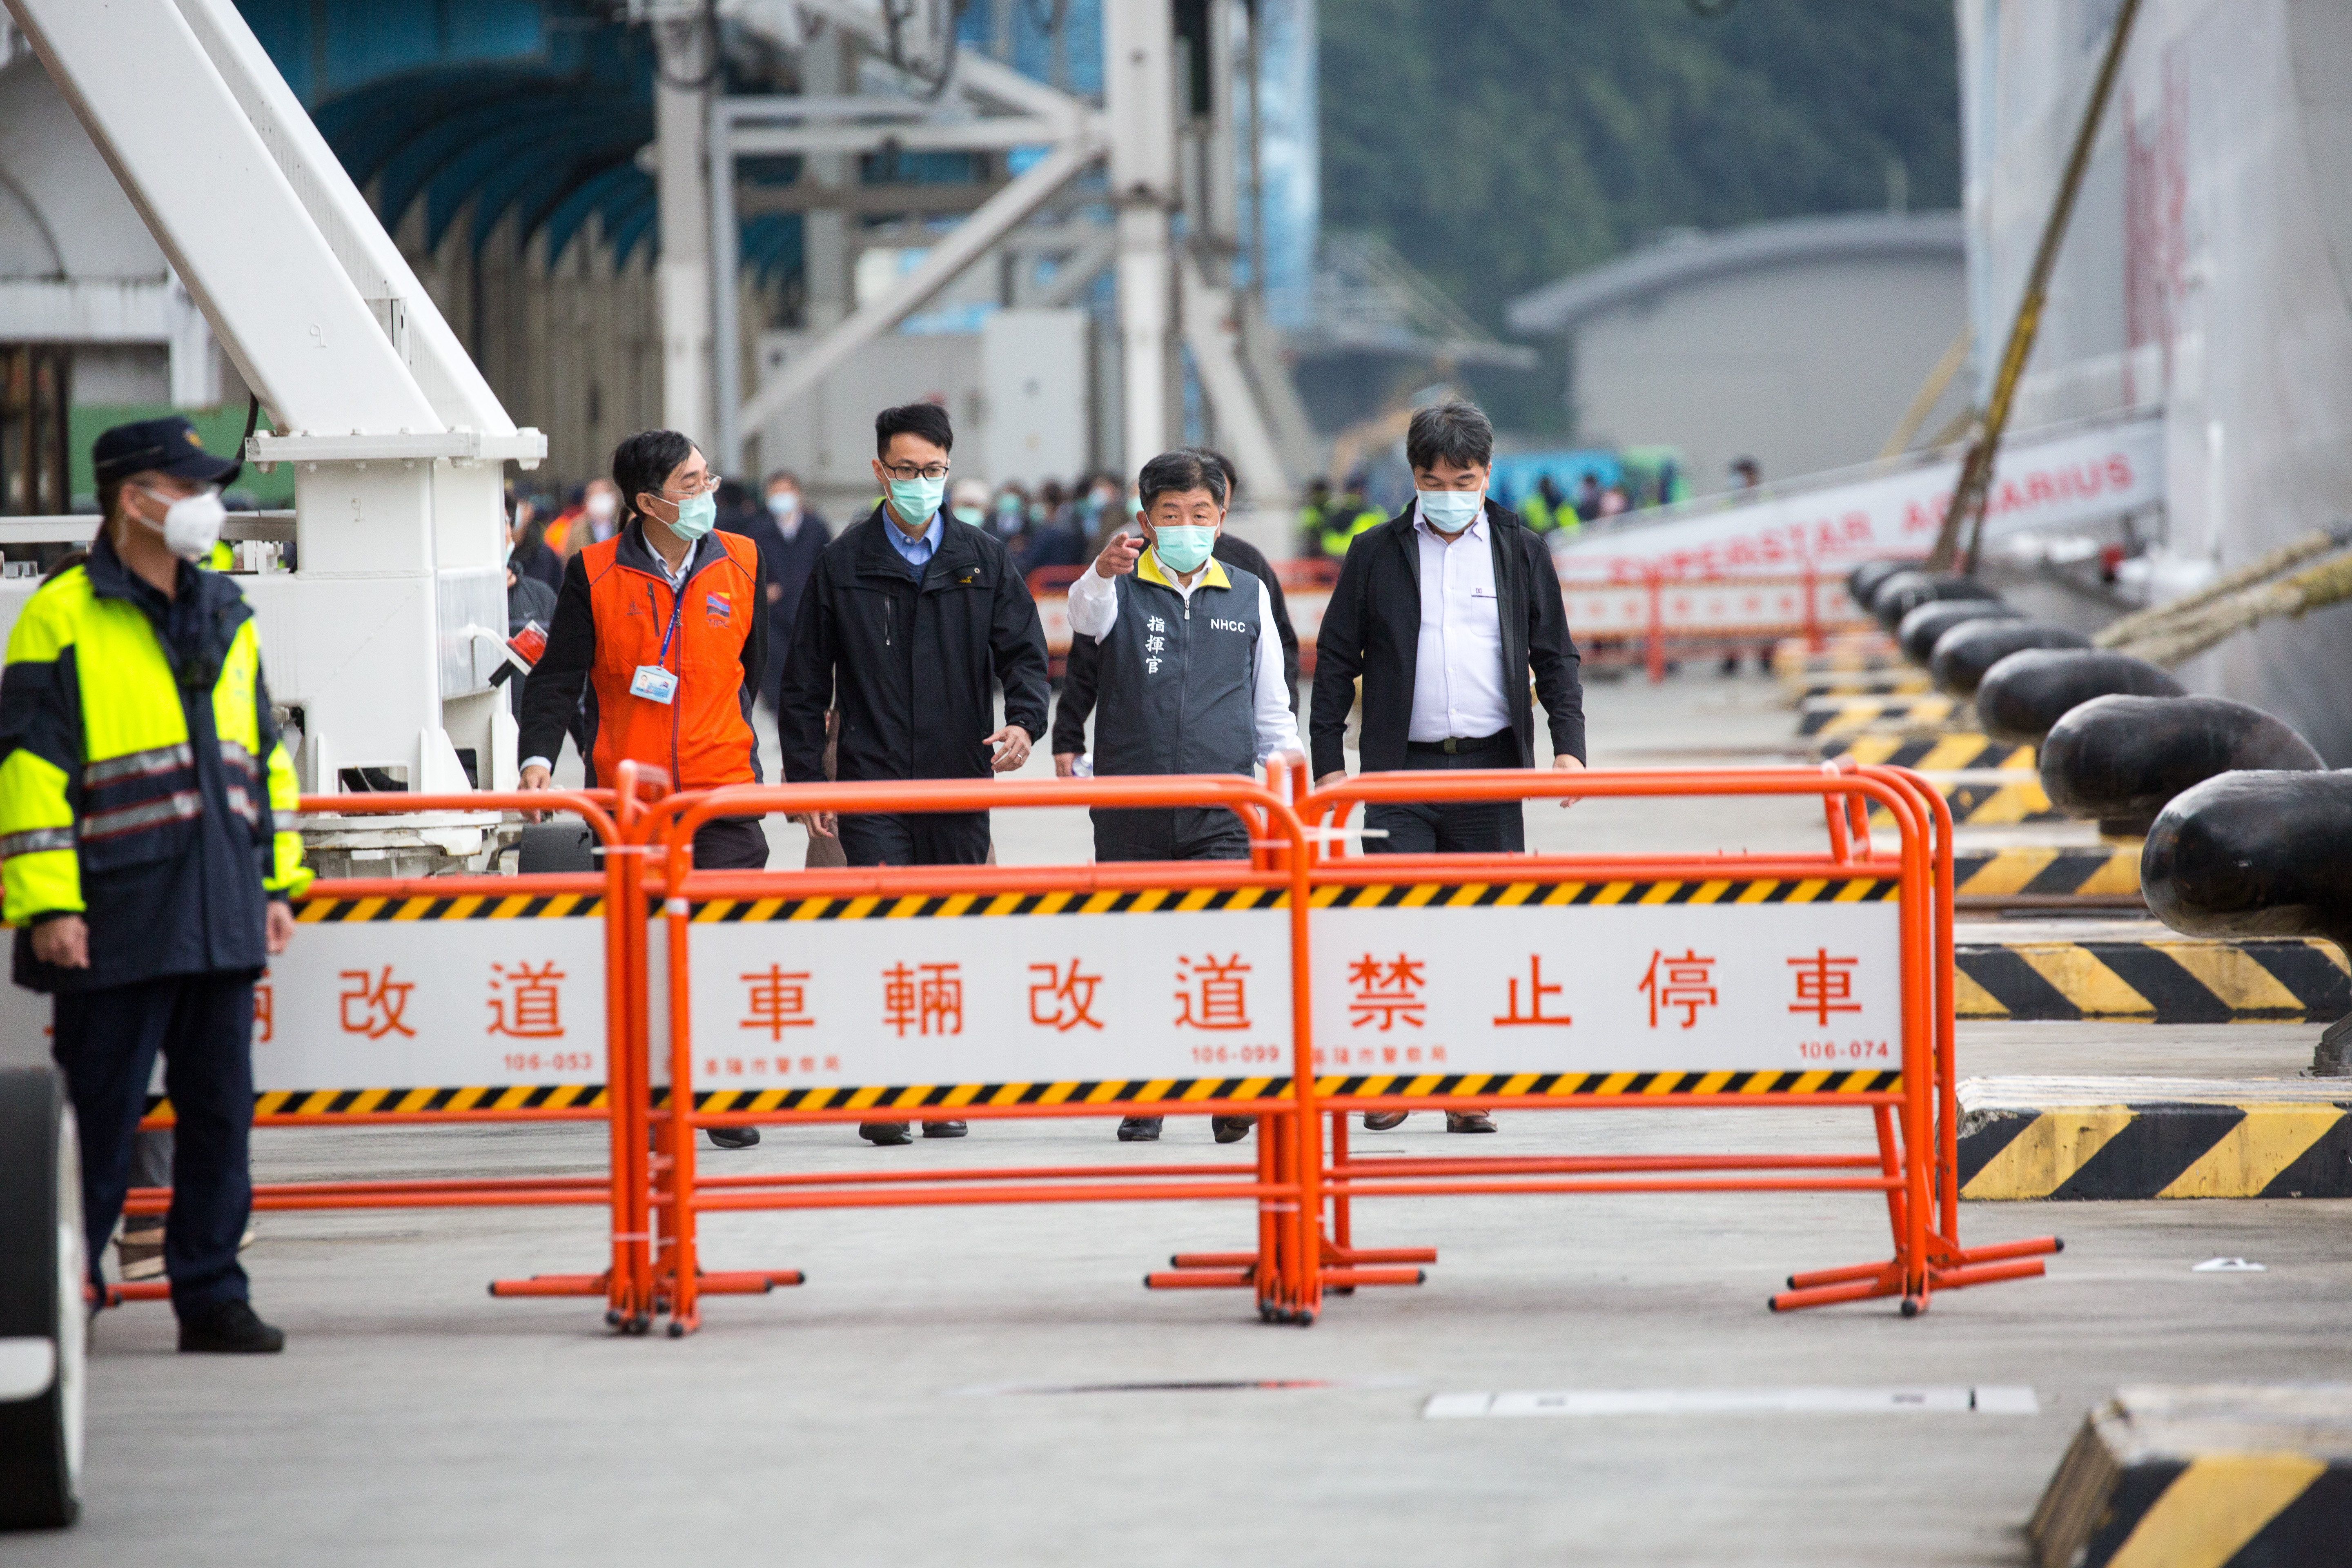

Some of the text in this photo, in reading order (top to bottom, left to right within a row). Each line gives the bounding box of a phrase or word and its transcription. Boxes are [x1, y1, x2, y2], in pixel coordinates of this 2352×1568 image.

[706, 619, 730, 628] TIPC
[1210, 618, 1245, 633] NHCC
[1145, 615, 1165, 674] 指揮官
[738, 951, 1253, 1043] 車輛改道
[1347, 947, 1863, 1033] 禁止停車
[1192, 1045, 1280, 1063] 106-099
[1800, 1040, 1889, 1060] 106-074
[504, 1052, 592, 1071] 106-053
